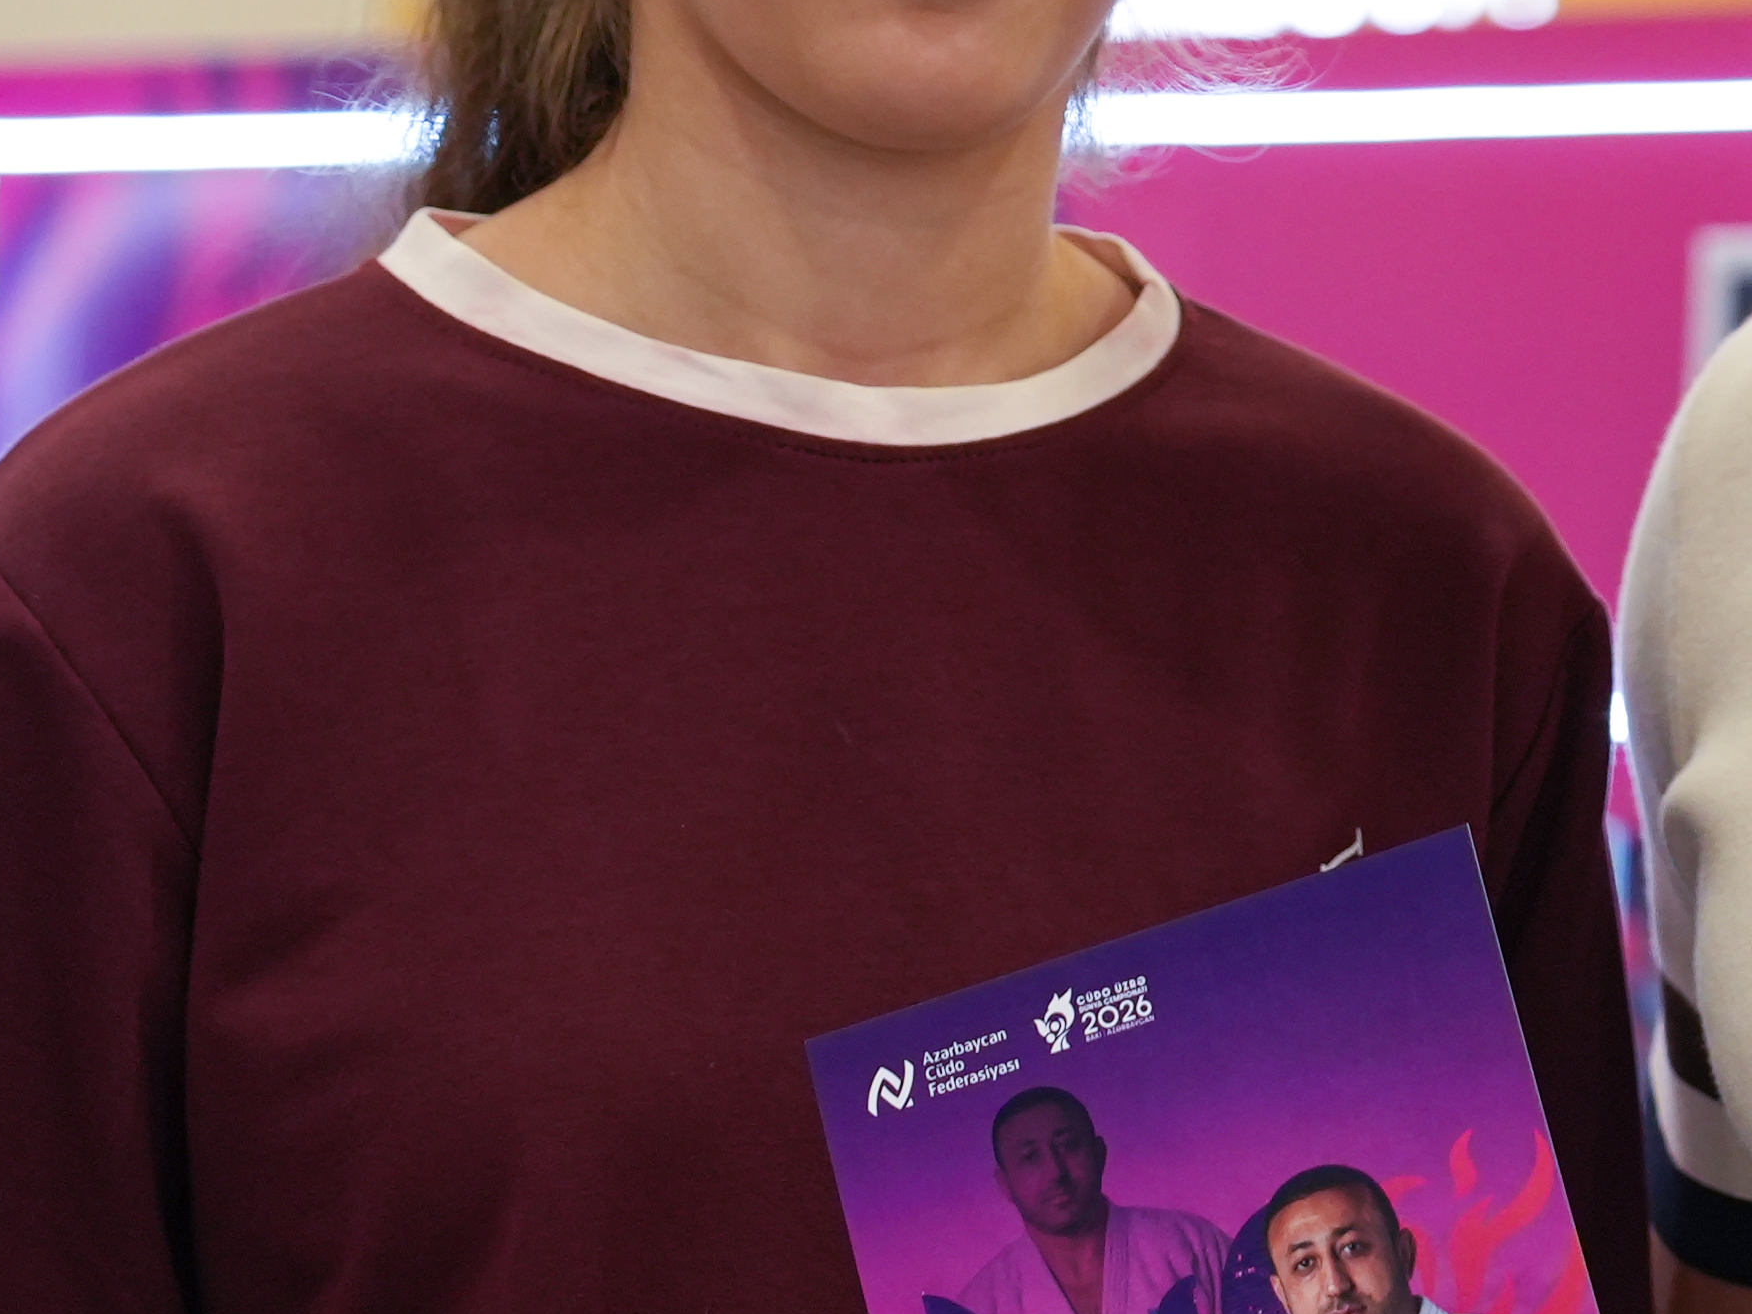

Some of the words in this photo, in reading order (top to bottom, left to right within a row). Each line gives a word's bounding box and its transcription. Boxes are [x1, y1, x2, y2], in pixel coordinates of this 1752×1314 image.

[1076, 986, 1111, 1006] CÜDO
[1081, 994, 1153, 1036] 2026
[923, 1029, 1008, 1066] Azərbaycan
[925, 1059, 965, 1081] Cüdo
[928, 1058, 1021, 1097] Federasiyası
